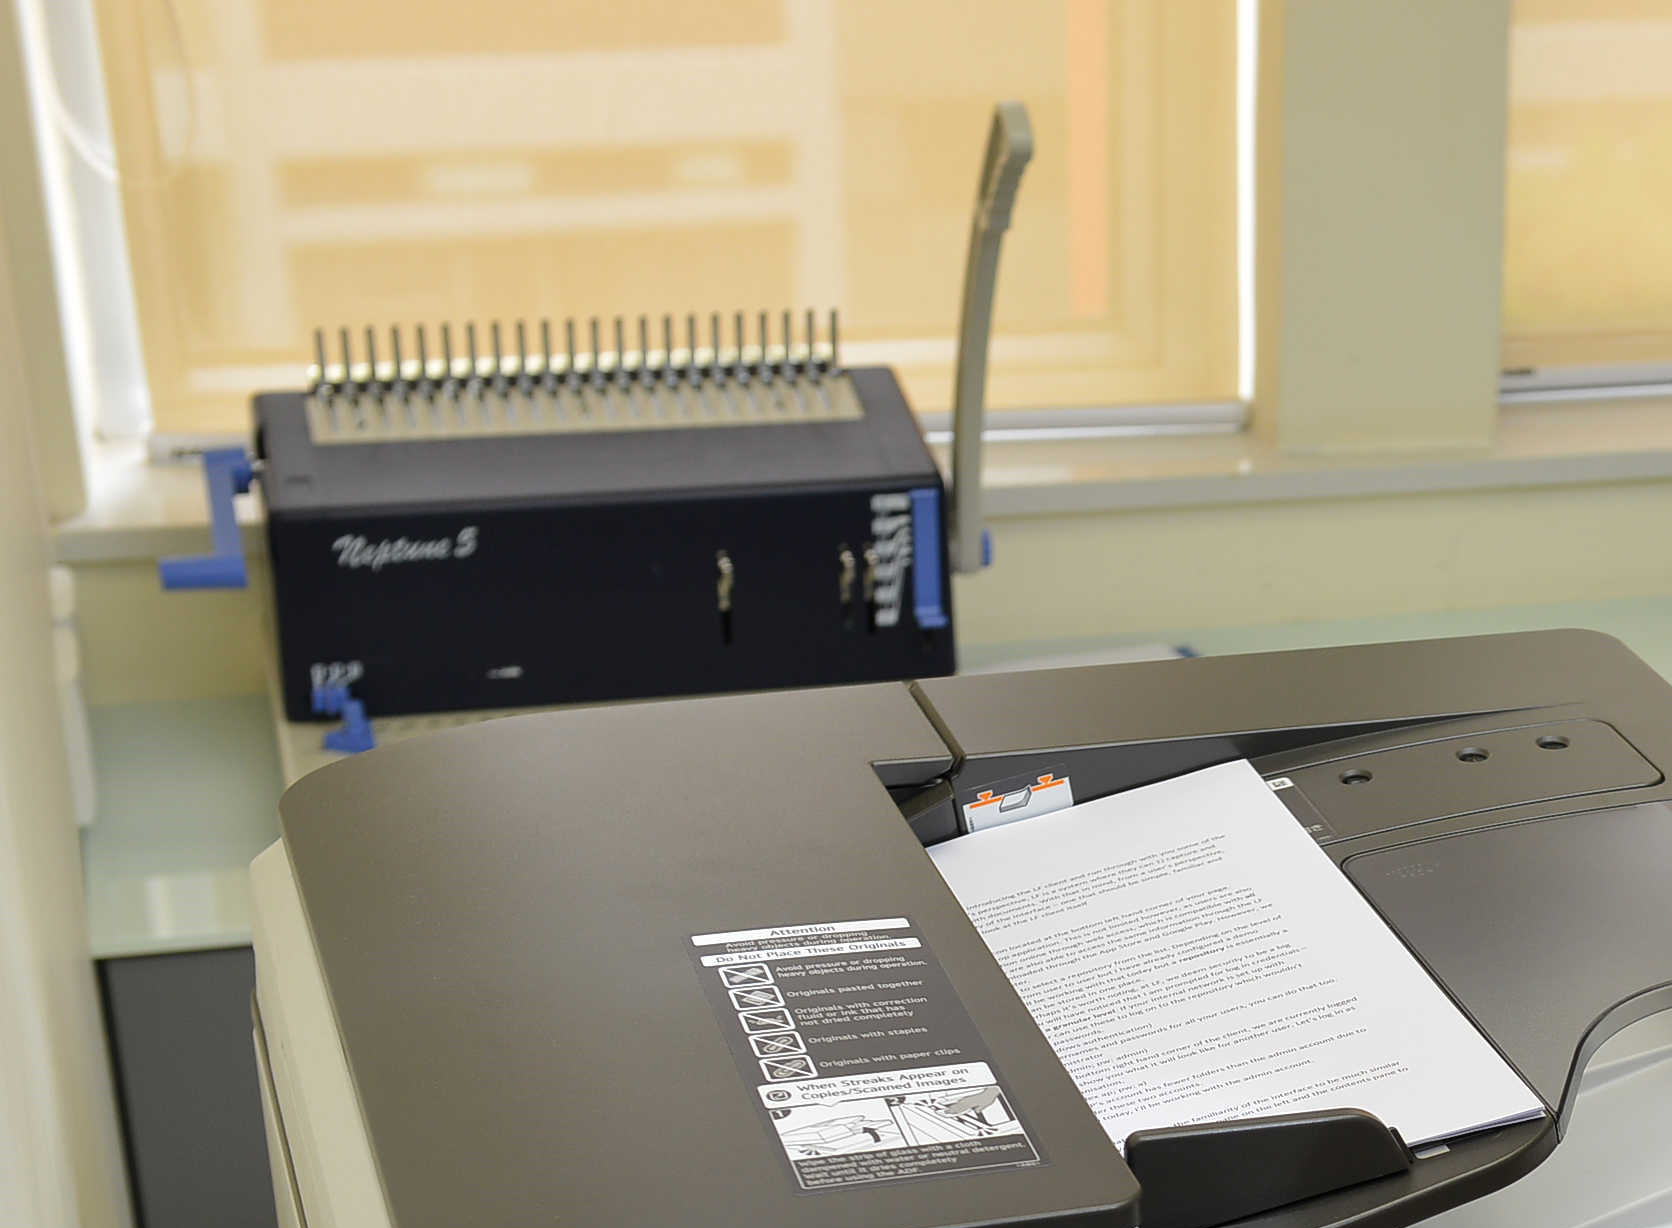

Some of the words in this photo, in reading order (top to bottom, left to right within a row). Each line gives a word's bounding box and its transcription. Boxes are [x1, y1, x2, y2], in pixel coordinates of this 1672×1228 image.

[331, 534, 452, 572] Neptune
[770, 926, 835, 935] Attention
[767, 950, 802, 958] Place
[807, 946, 844, 954] These
[849, 940, 906, 950] Originals
[775, 965, 803, 973] Avoid
[805, 961, 847, 969] pressure
[787, 988, 835, 997] Originals
[837, 984, 874, 992] pasted
[877, 980, 923, 988] together
[795, 1005, 843, 1014] Originals
[872, 996, 928, 1006] correction
[854, 1010, 914, 1021] completely
[809, 1034, 857, 1044] Originals
[860, 1031, 885, 1039] with
[888, 1027, 928, 1035] staples
[820, 1058, 869, 1068] Originals
[872, 1054, 896, 1062] with
[898, 1051, 930, 1059] paper
[933, 1047, 961, 1055] clips
[797, 1083, 836, 1092] When
[840, 1076, 894, 1087] Streaks
[898, 1070, 946, 1080] Appear
[801, 1082, 910, 1099] Copies/Scanned
[916, 1076, 967, 1086] Images
